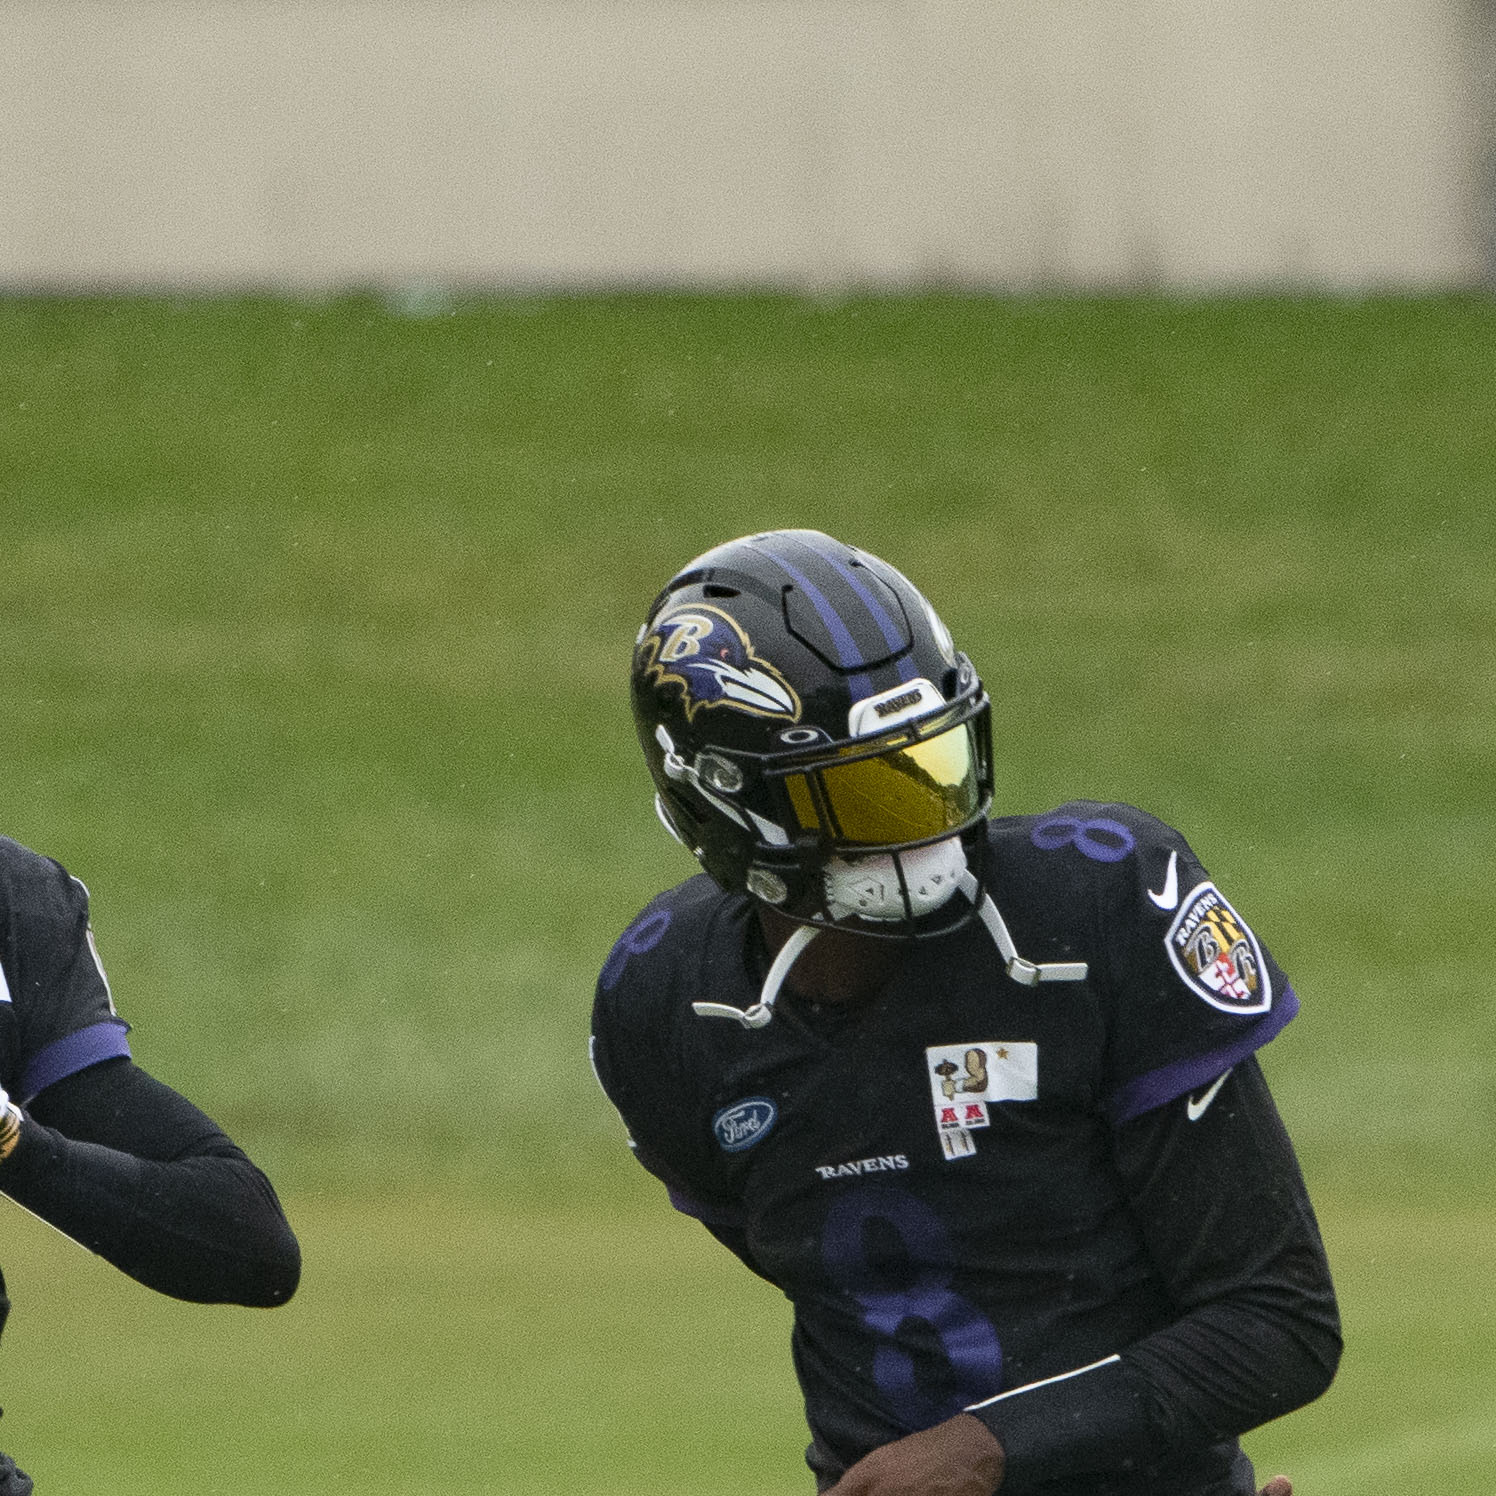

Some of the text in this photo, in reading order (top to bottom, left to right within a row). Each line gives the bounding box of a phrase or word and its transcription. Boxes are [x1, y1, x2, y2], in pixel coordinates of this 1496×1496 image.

[659, 614, 714, 662] B
[1030, 815, 1136, 863] 8
[1175, 892, 1220, 947] RAVENS
[814, 1154, 910, 1180] RAVENS
[821, 1185, 1003, 1434] 8
